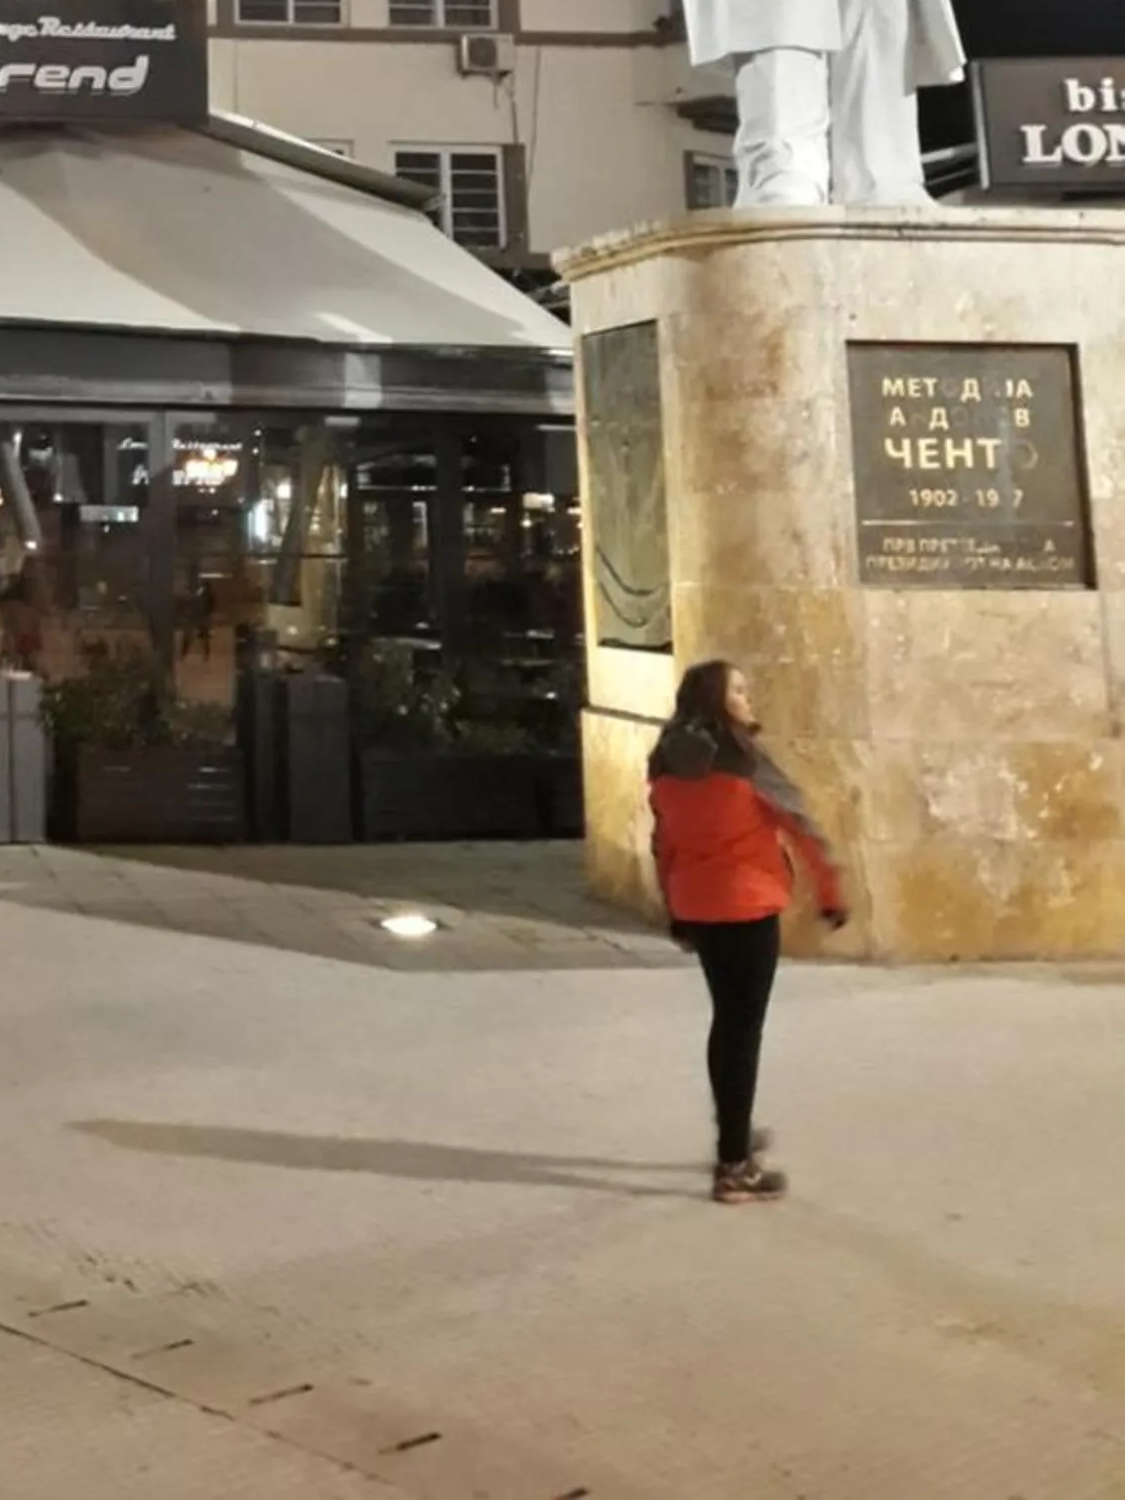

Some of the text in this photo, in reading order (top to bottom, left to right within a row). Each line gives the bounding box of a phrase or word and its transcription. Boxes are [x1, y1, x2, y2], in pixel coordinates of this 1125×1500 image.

[38, 16, 177, 41] Restaurant
[909, 488, 1024, 509] 1902 197
